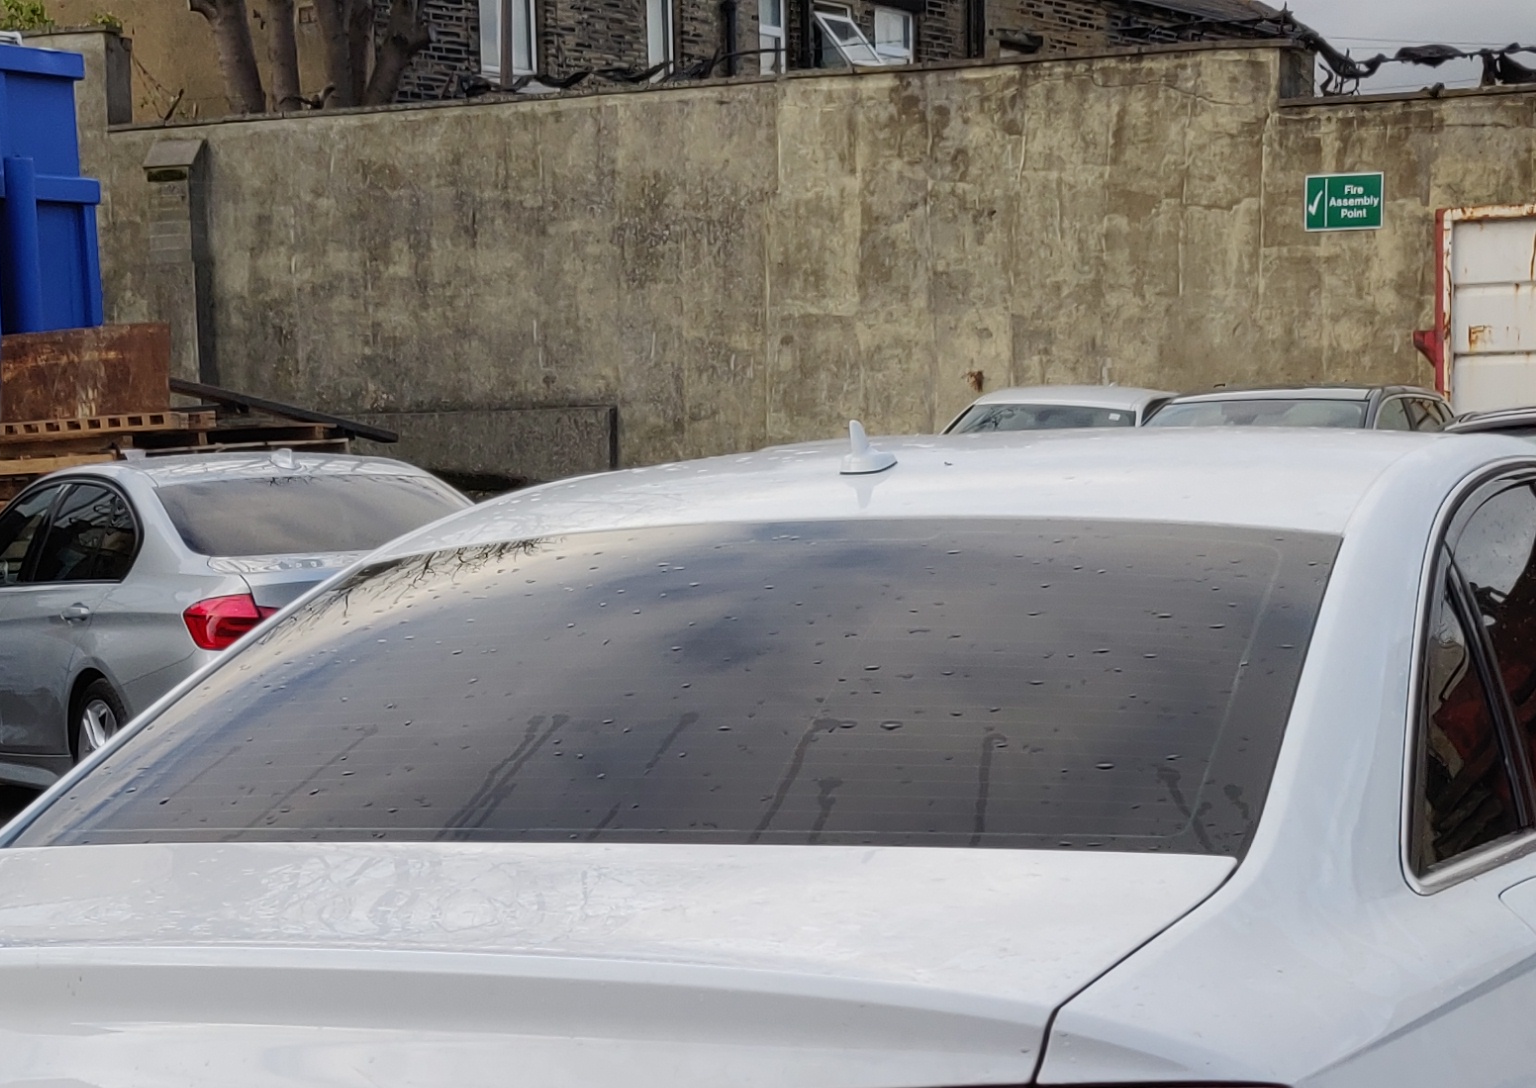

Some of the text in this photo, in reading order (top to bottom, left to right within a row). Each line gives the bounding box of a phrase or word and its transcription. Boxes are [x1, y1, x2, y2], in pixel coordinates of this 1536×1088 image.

[1344, 185, 1364, 195] Fire
[1329, 195, 1379, 207] Assembly
[1341, 208, 1367, 218] Point
